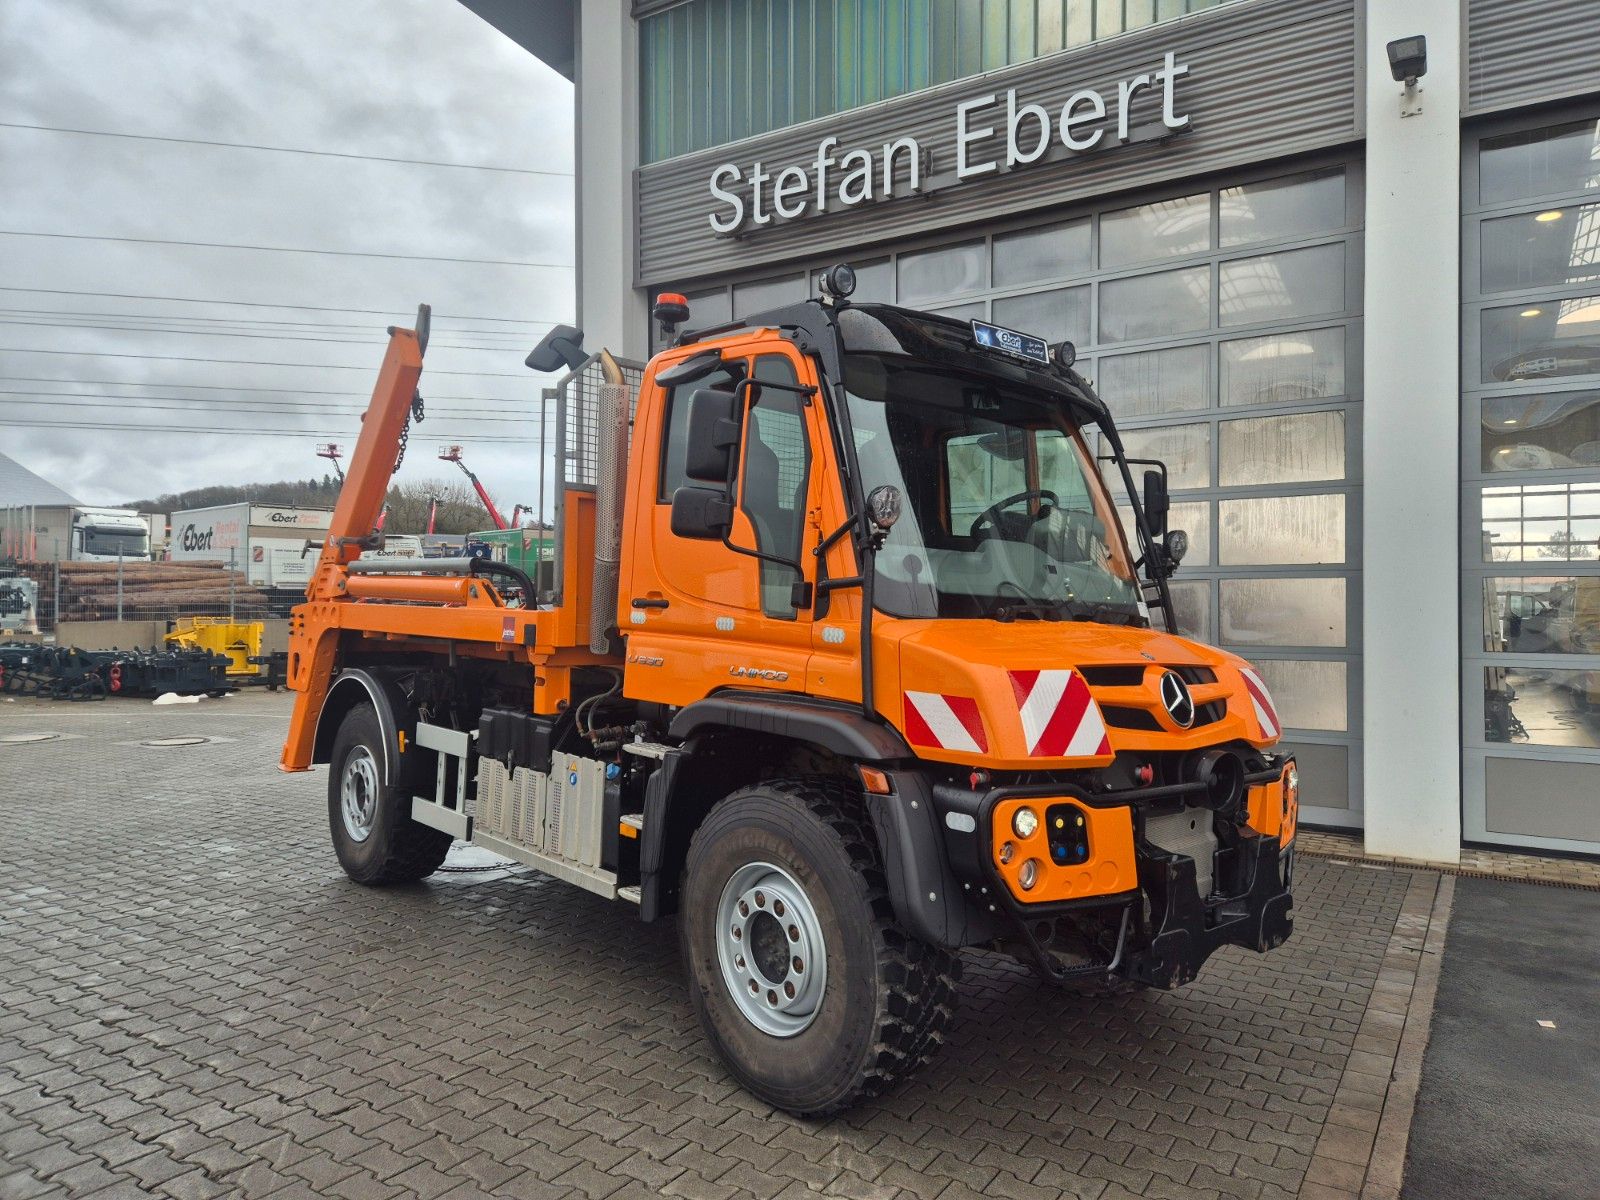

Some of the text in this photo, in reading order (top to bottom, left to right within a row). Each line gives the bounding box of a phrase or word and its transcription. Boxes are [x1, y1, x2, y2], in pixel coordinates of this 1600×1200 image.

[708, 51, 1190, 234] Stefan Ebert
[271, 512, 298, 523] Ebert
[184, 523, 214, 551] Ebert
[377, 549, 397, 557] Ebert
[729, 665, 789, 682] UNIMOG
